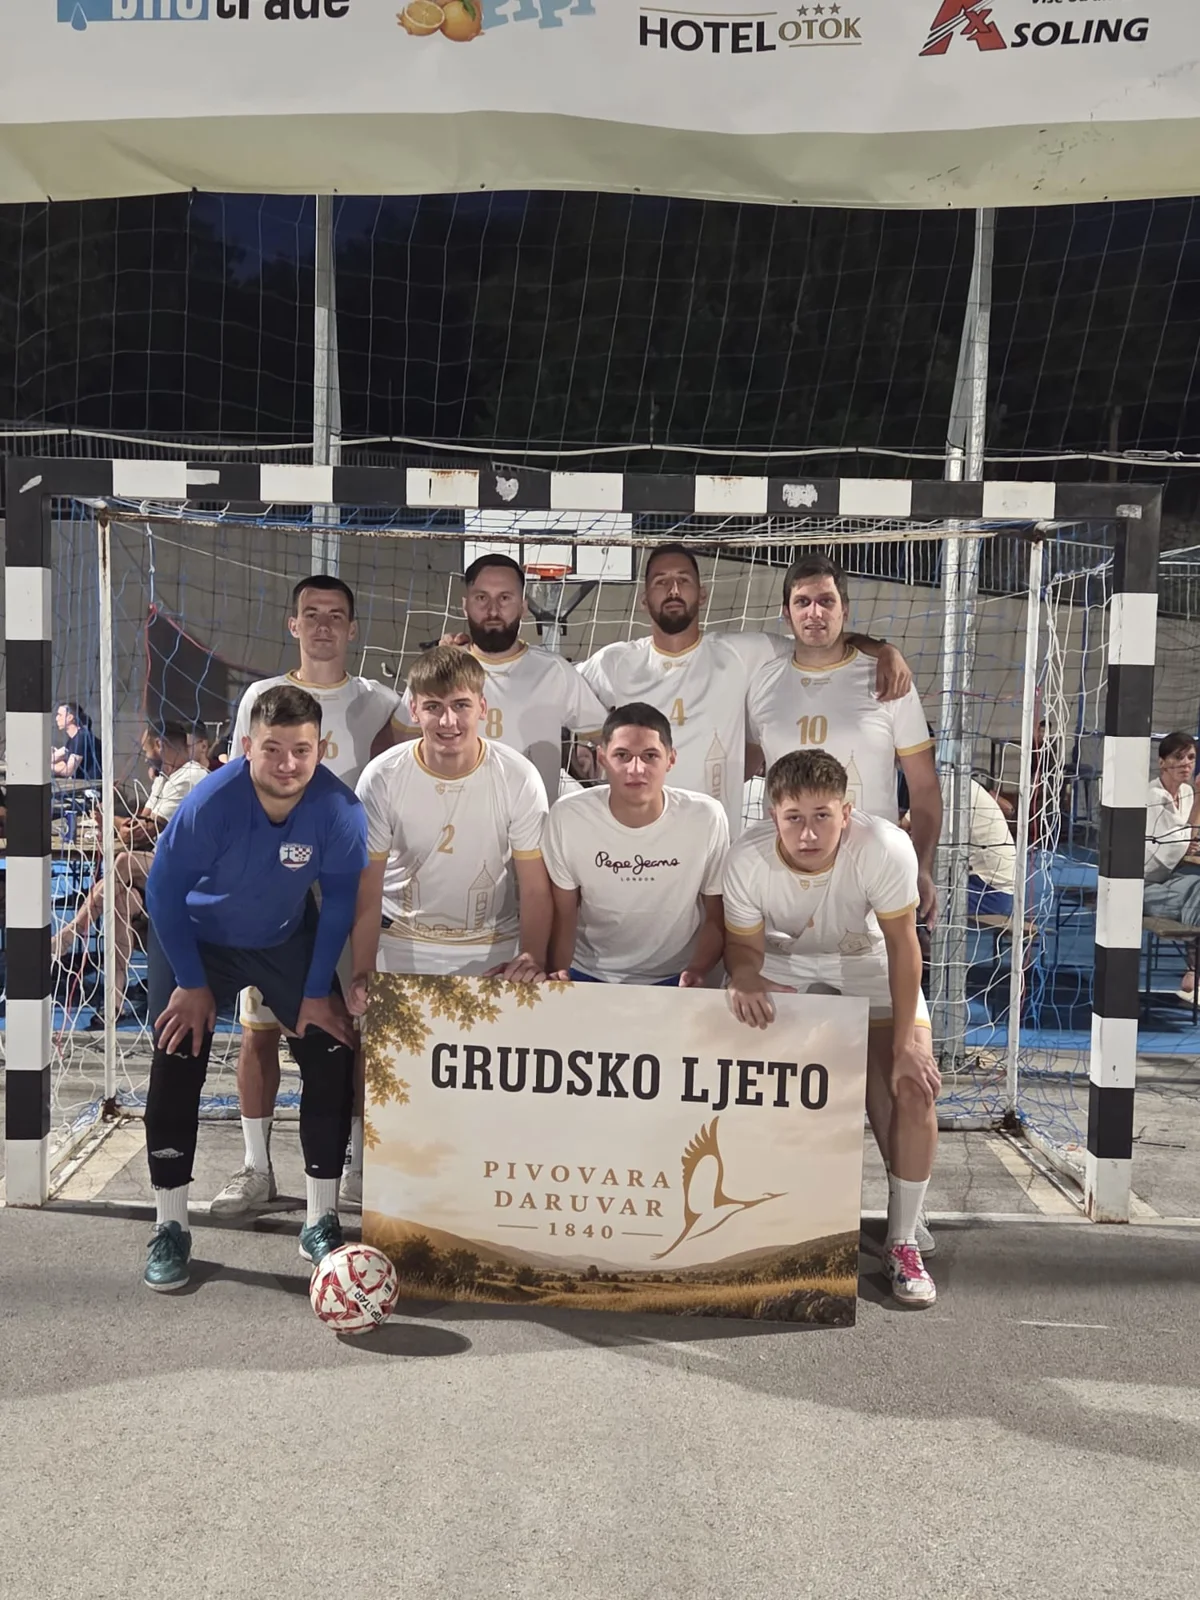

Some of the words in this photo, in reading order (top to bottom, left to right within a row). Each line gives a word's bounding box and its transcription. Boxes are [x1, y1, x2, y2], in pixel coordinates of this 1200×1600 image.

[639, 15, 776, 53] HOTEL
[778, 17, 862, 41] OTOK
[1011, 18, 1149, 47] SOLING
[485, 708, 503, 739] 8
[669, 698, 688, 726] 4
[324, 730, 339, 759] 6
[796, 715, 828, 745] 10
[437, 824, 455, 854] 2
[595, 851, 632, 874] Pepe
[632, 854, 680, 875] Jeans
[431, 1043, 660, 1100] GRUDSKO
[681, 1056, 829, 1110] LJETO
[483, 1161, 671, 1189] PIVOVARA
[494, 1190, 664, 1217] DARUVAR
[549, 1222, 613, 1239] 1840
